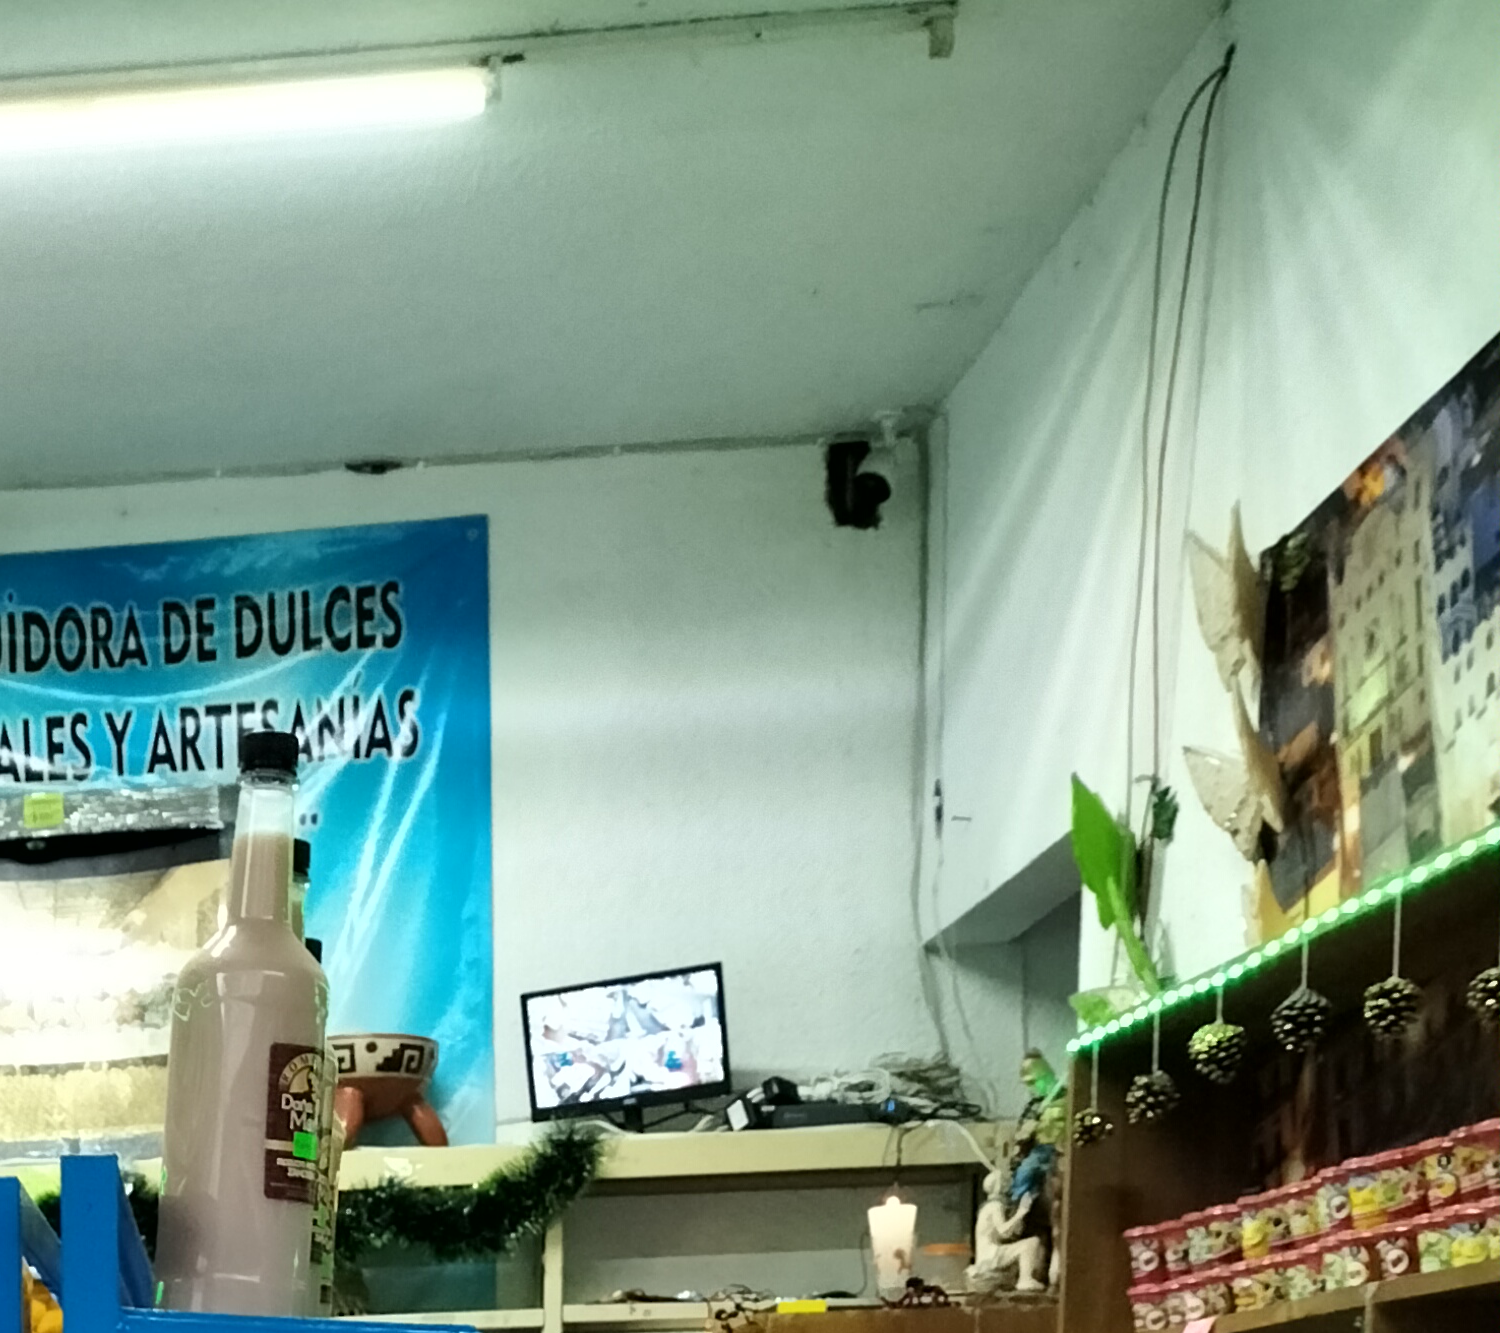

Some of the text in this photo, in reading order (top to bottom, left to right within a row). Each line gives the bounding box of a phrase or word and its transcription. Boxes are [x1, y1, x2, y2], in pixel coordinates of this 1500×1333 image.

[163, 598, 217, 665] DE
[234, 580, 402, 659] DULCES
[105, 710, 133, 776] Y
